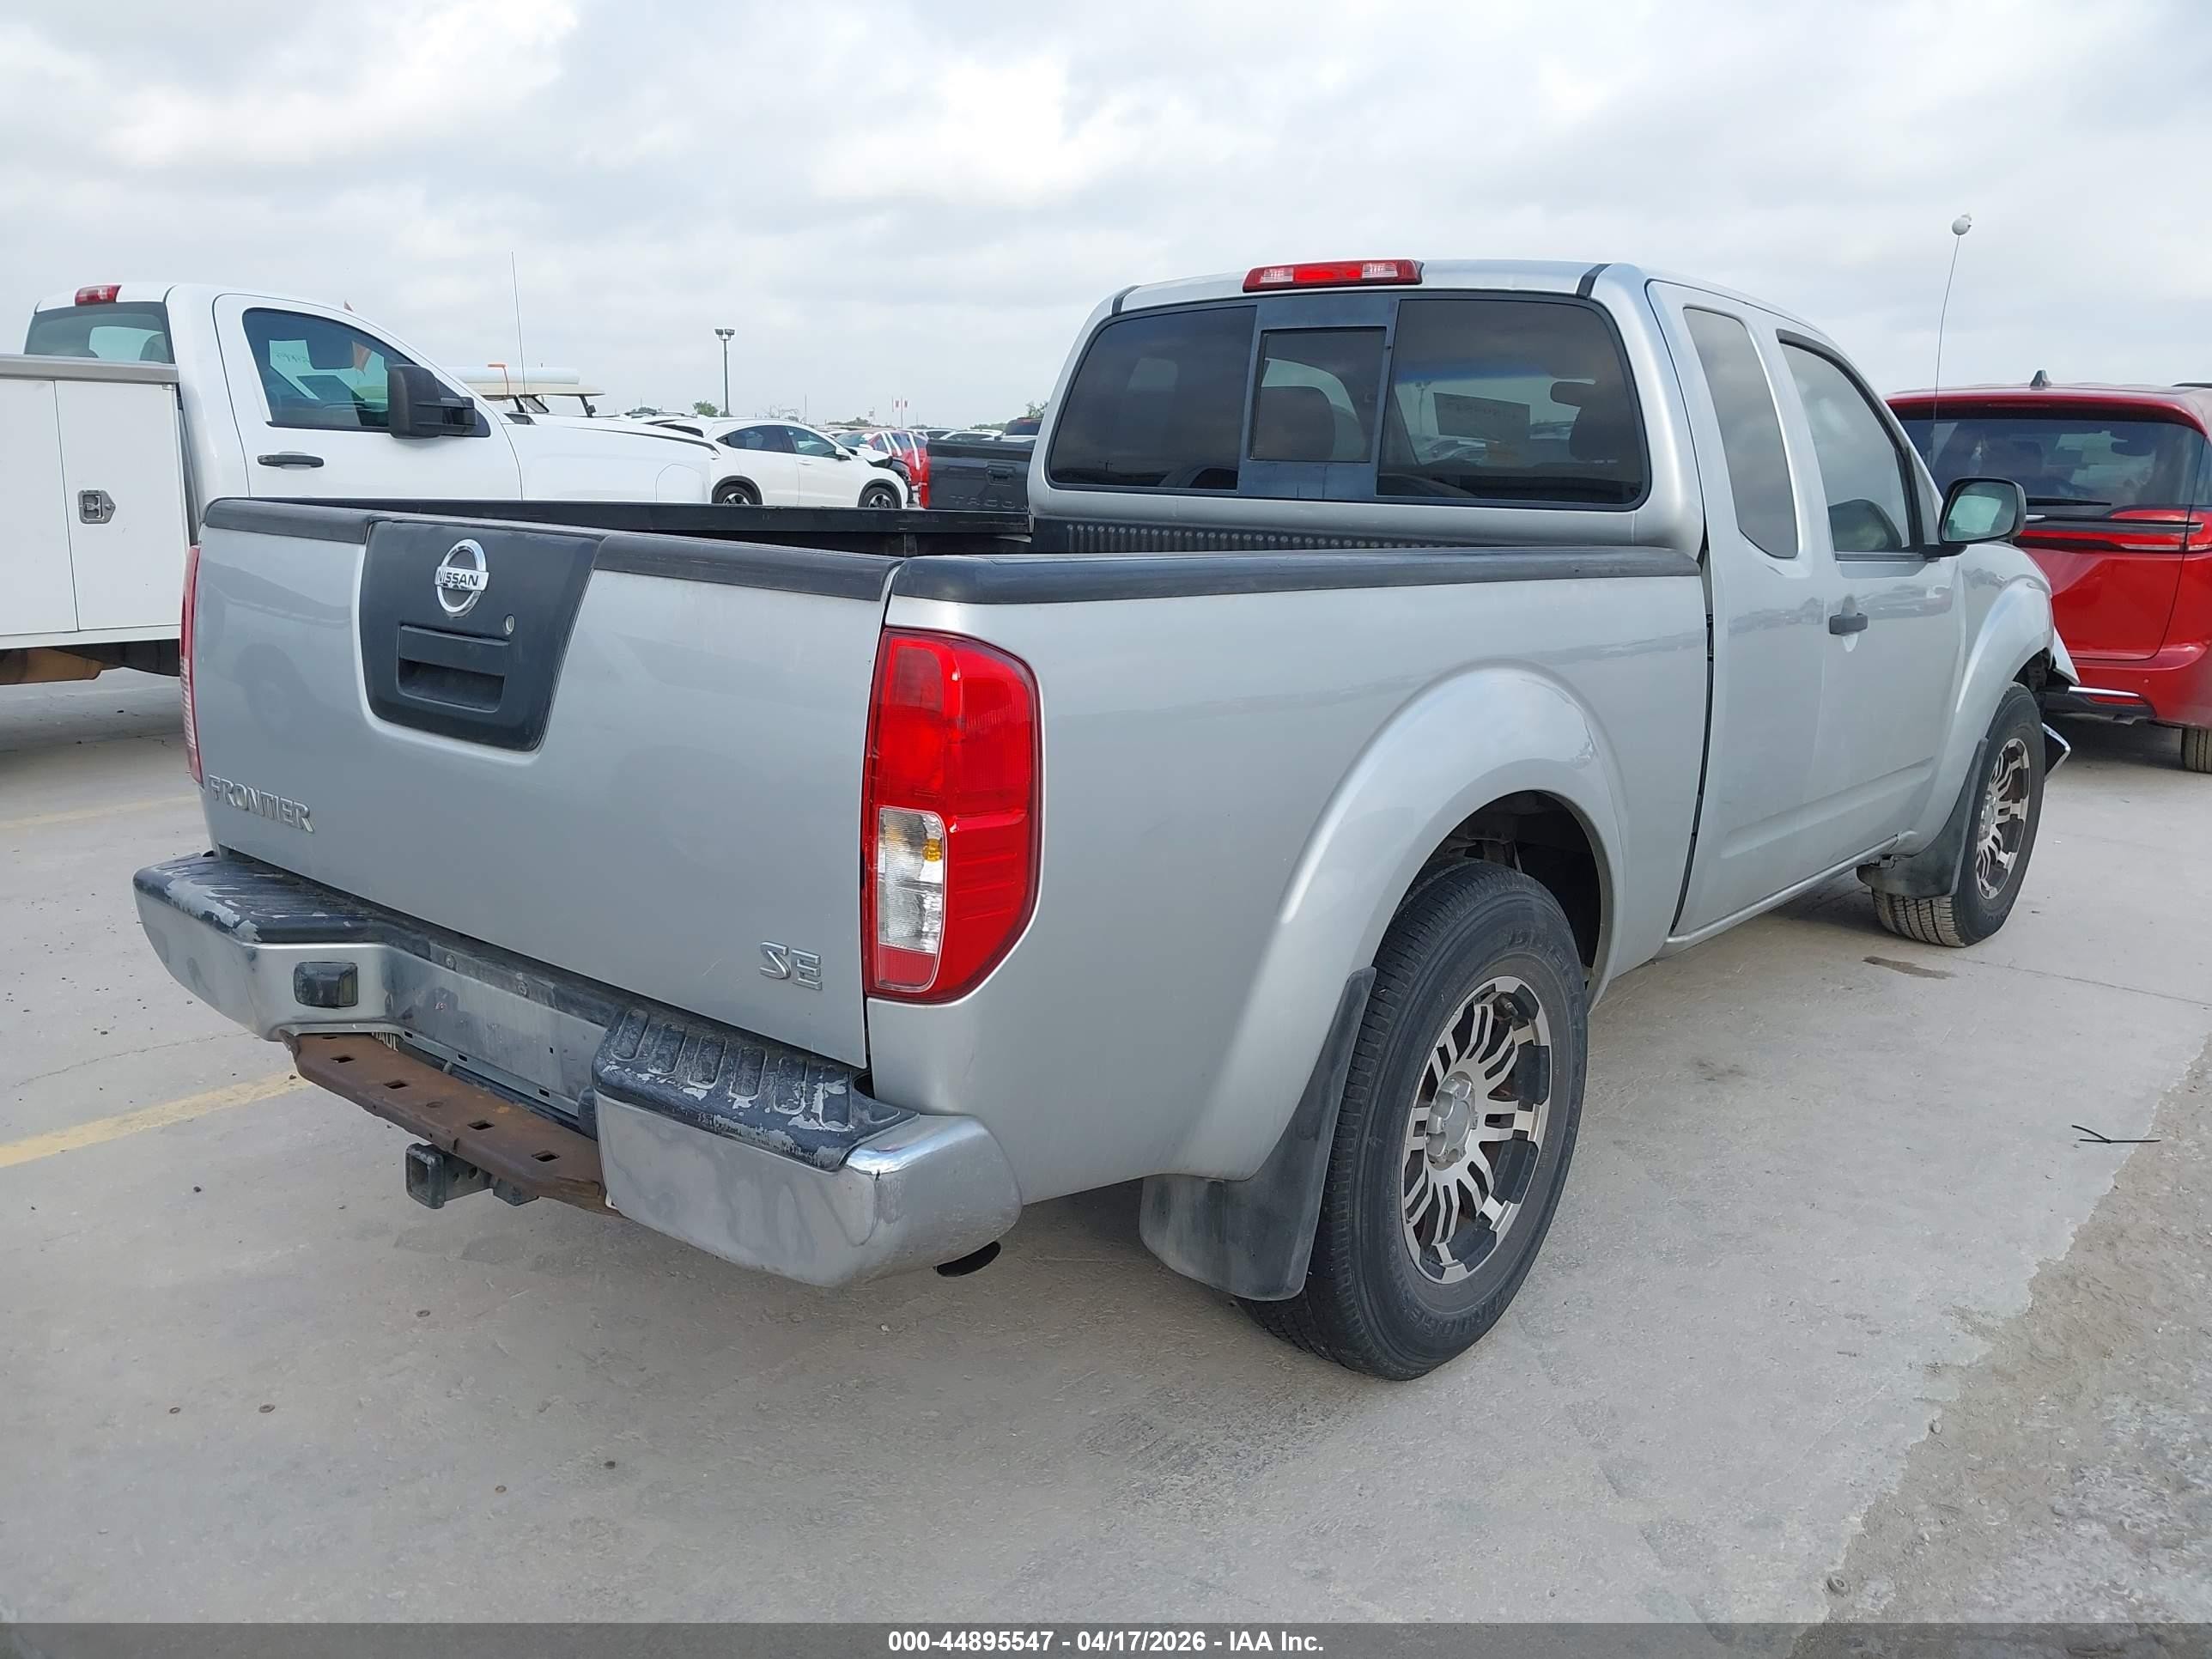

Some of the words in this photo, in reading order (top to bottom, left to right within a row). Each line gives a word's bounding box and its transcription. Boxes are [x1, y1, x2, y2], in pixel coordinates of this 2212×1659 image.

[438, 570, 479, 586] NISSAN
[208, 774, 314, 833] FRONTIER
[759, 940, 823, 991] SE
